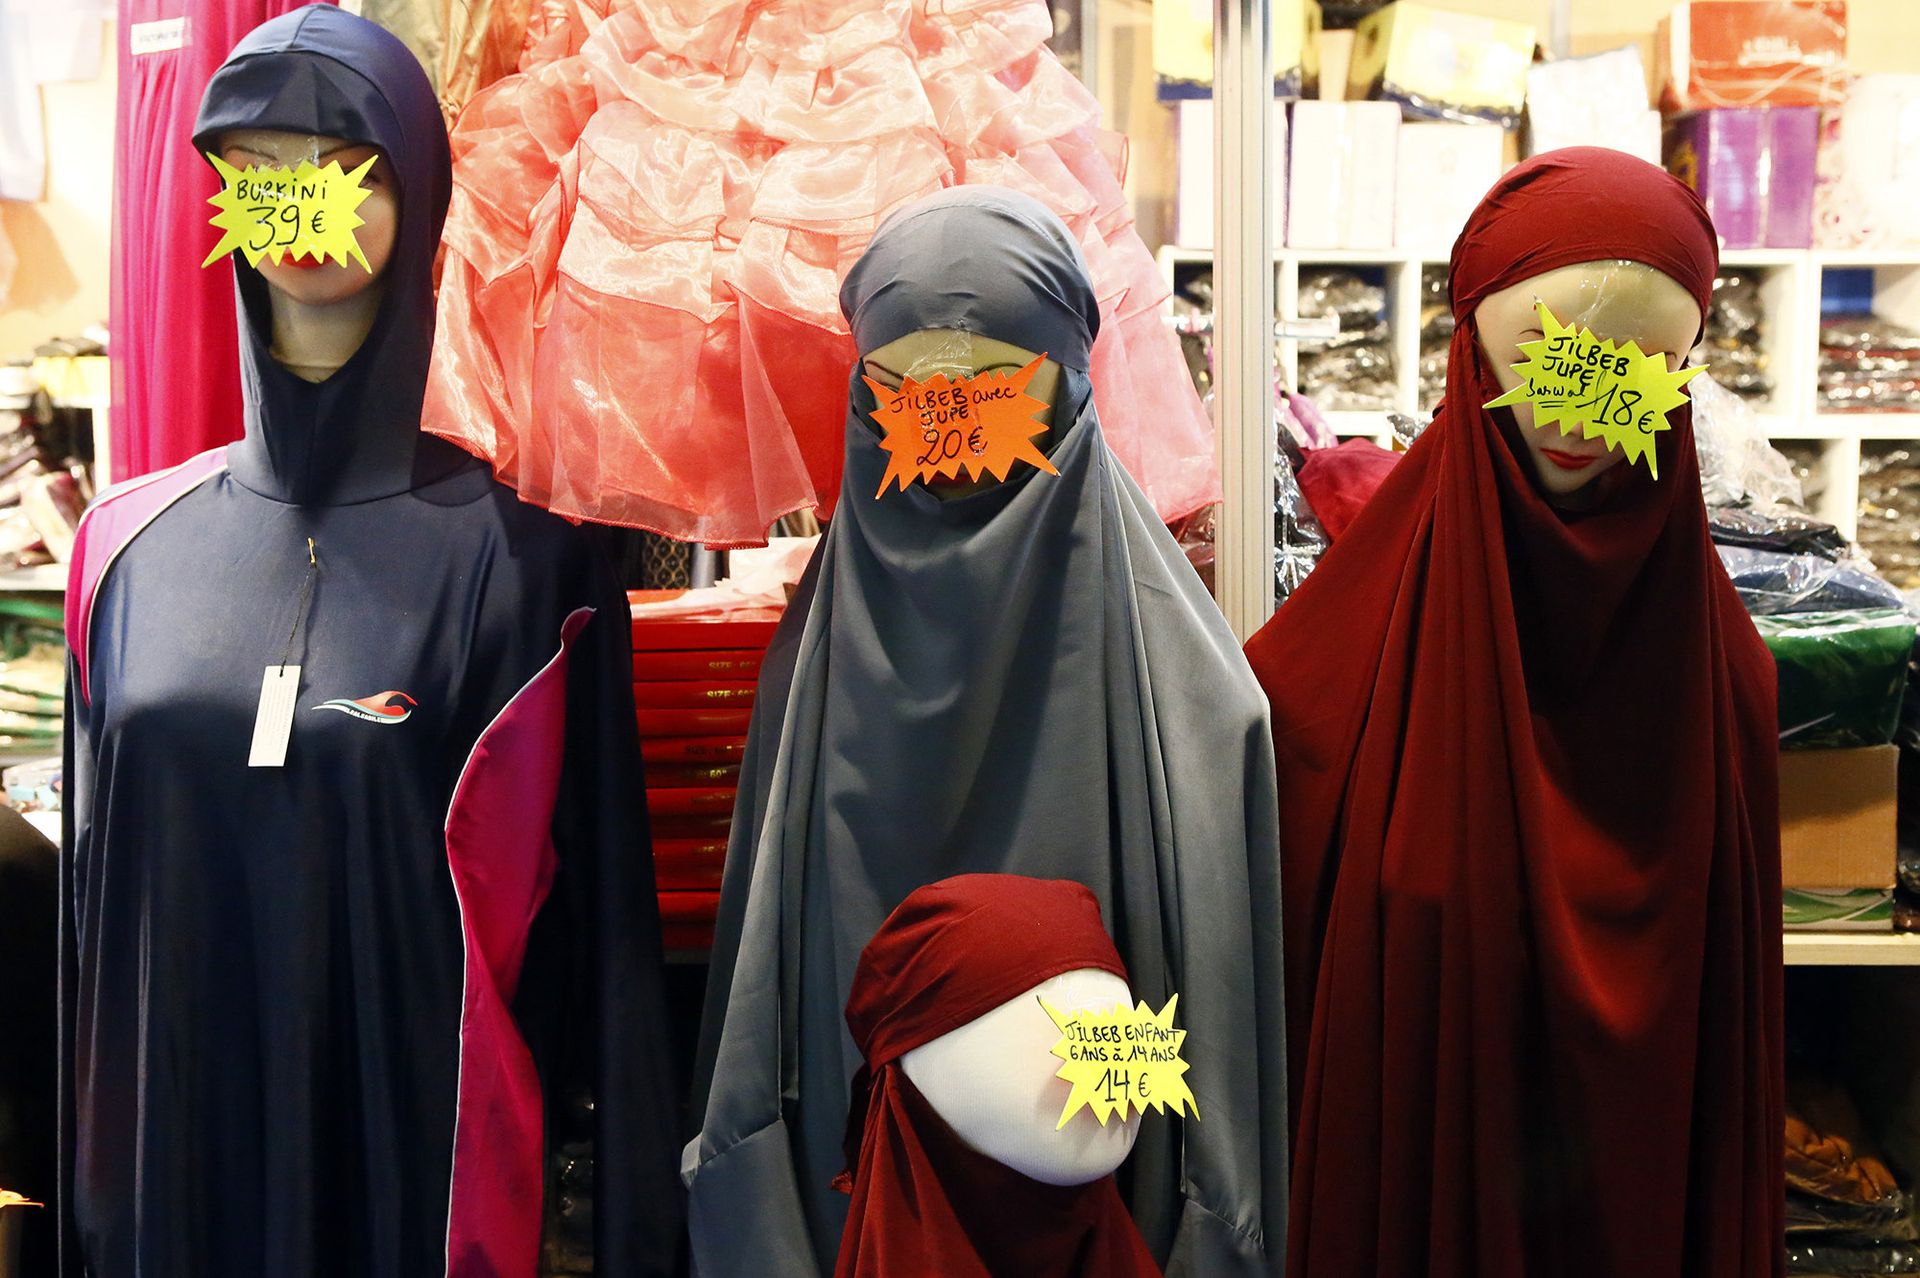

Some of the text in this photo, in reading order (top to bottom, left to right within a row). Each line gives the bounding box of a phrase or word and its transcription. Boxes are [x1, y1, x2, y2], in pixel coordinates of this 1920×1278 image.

[247, 204, 326, 251] 39 €
[1542, 355, 1596, 387] JUPE
[972, 386, 1017, 404] avec
[920, 404, 969, 426] JUPE
[1124, 1022, 1181, 1043] ENFANT
[1094, 1067, 1152, 1103] 14 €
